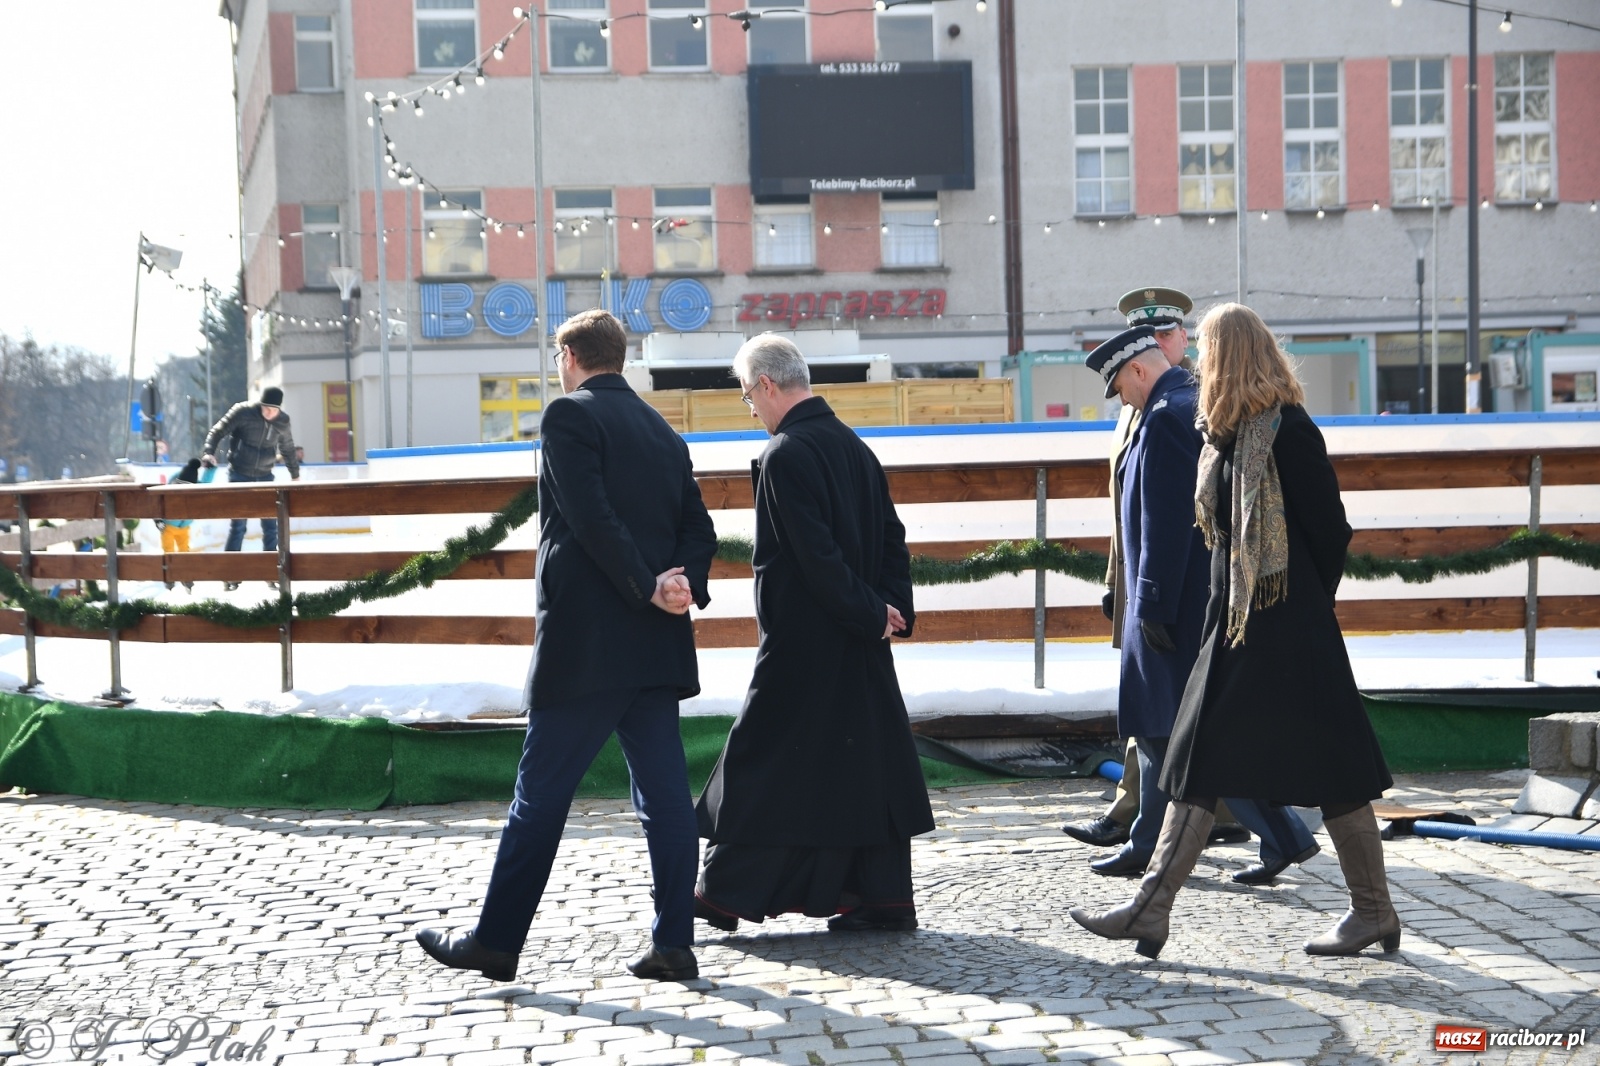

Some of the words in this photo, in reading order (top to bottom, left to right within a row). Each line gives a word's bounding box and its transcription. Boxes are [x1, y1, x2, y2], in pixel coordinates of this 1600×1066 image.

[820, 62, 837, 74] tel.
[839, 62, 858, 74] 533
[860, 62, 879, 74] 355
[880, 61, 900, 73] 677
[810, 177, 917, 191] Telebimy-Raciborz.pl
[737, 288, 947, 329] zaprasza
